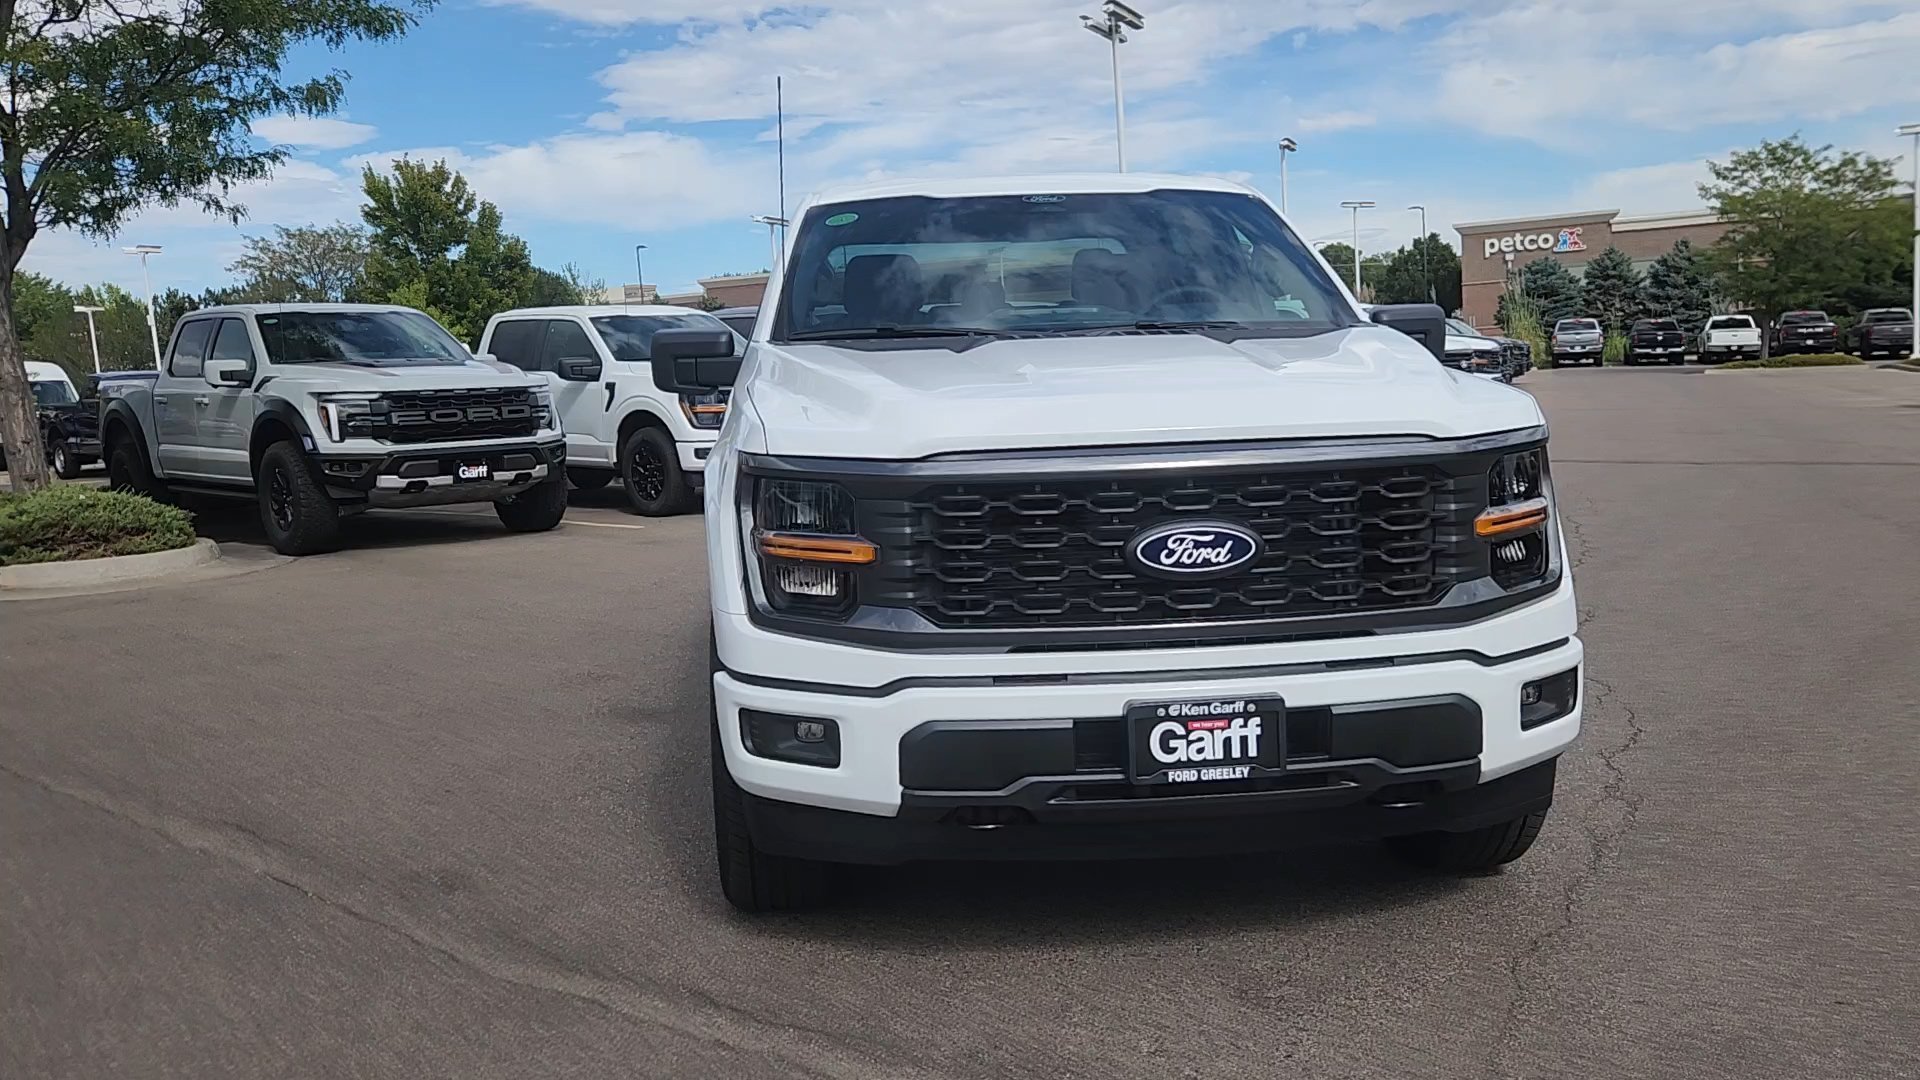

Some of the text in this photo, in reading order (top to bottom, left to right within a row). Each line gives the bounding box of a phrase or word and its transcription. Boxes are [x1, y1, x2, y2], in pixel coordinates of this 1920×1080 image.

[1484, 232, 1554, 258] petco
[391, 405, 532, 425] FORD
[459, 465, 488, 478] Garff
[1160, 534, 1234, 565] Ford
[1181, 701, 1245, 716] Ken Garff
[1149, 716, 1262, 764] Garff
[1168, 767, 1249, 782] FORD GREELEY
